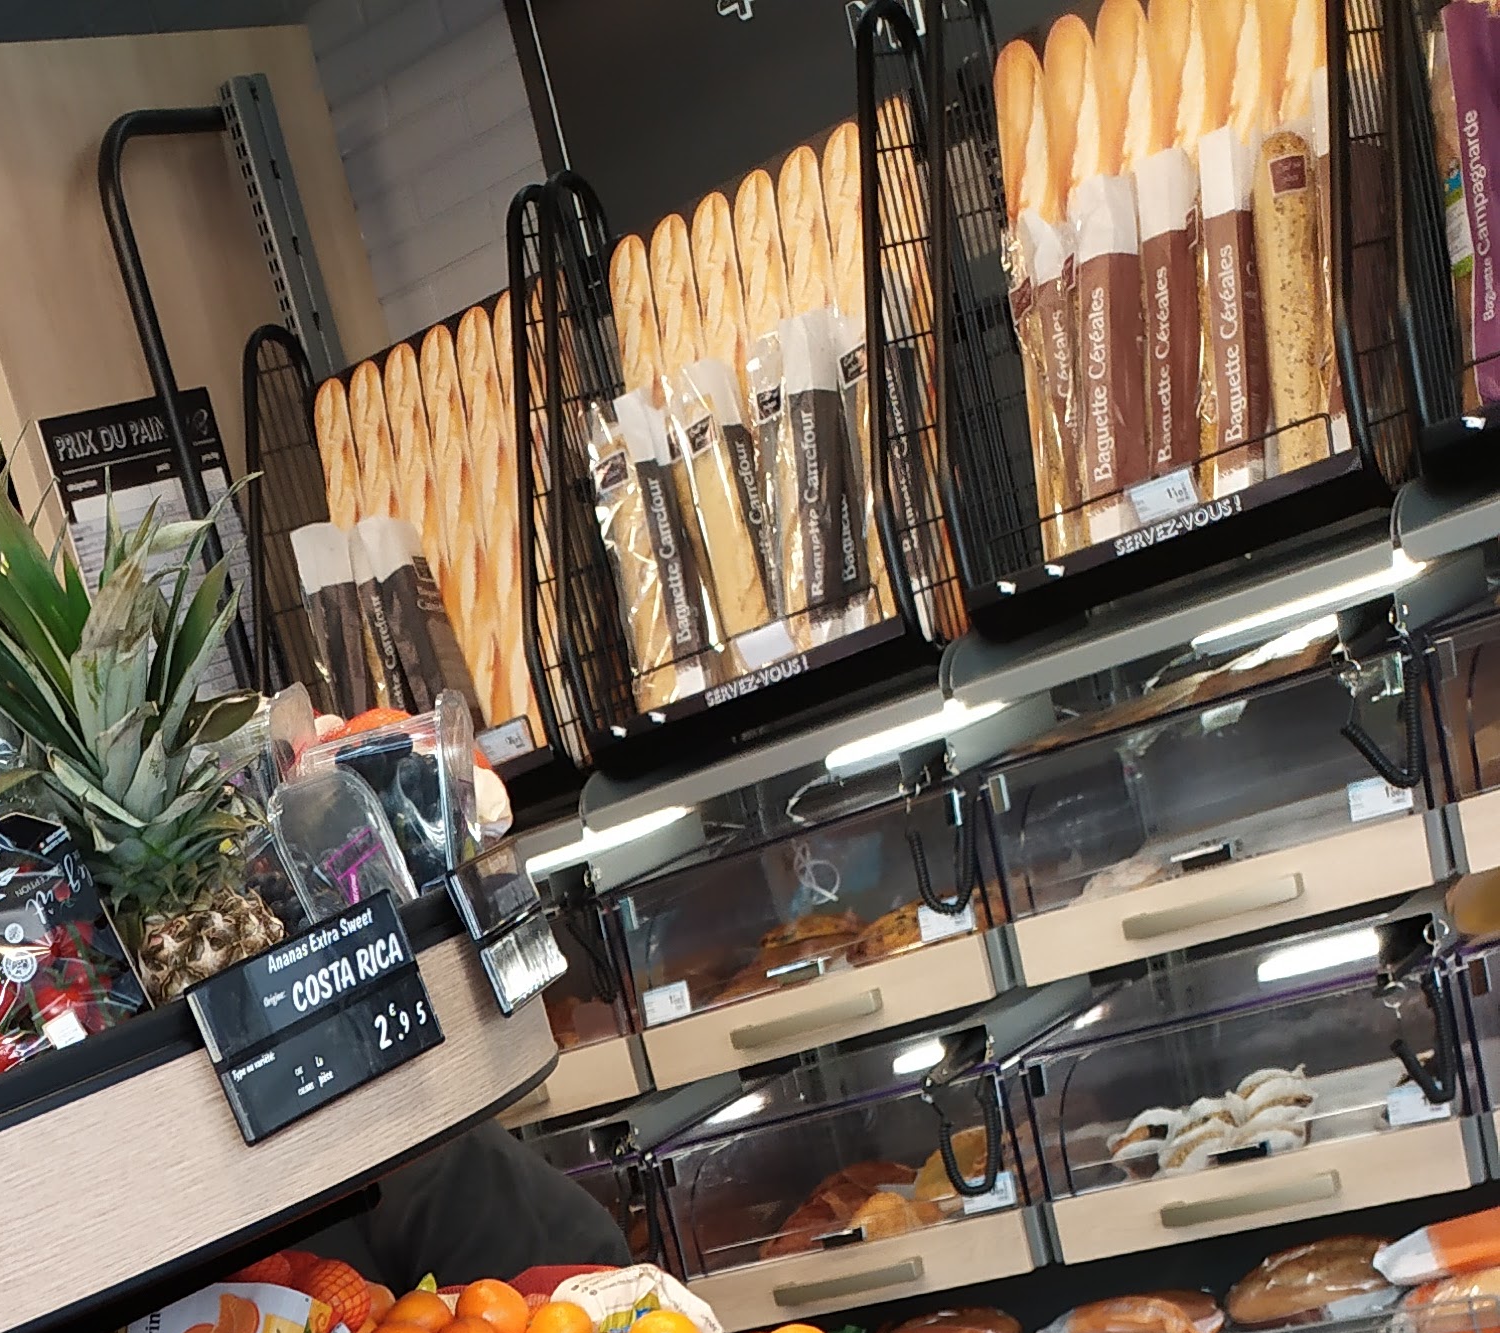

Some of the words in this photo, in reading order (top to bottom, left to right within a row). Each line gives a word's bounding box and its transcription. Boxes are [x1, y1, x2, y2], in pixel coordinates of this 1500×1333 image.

[1463, 109, 1490, 257] Campagnarde
[1086, 286, 1106, 383] Céréales
[1154, 265, 1169, 360] Céréales
[1218, 243, 1234, 343] Céréales
[53, 428, 99, 462] PRIX
[99, 422, 128, 453] DU
[1091, 385, 1115, 484] Baguette
[1157, 364, 1174, 464] Baguette
[1223, 347, 1248, 443] Baguette
[735, 438, 763, 527] Carrefour
[801, 408, 818, 494] Carrefour
[648, 476, 676, 561] Carrefour
[802, 493, 825, 599] Baguette
[663, 559, 691, 645] Baguette
[268, 940, 311, 976] Ananas
[309, 927, 340, 954] Extra
[338, 908, 374, 943] Sweet
[292, 962, 356, 1013] COSTA
[356, 931, 403, 988] RICA
